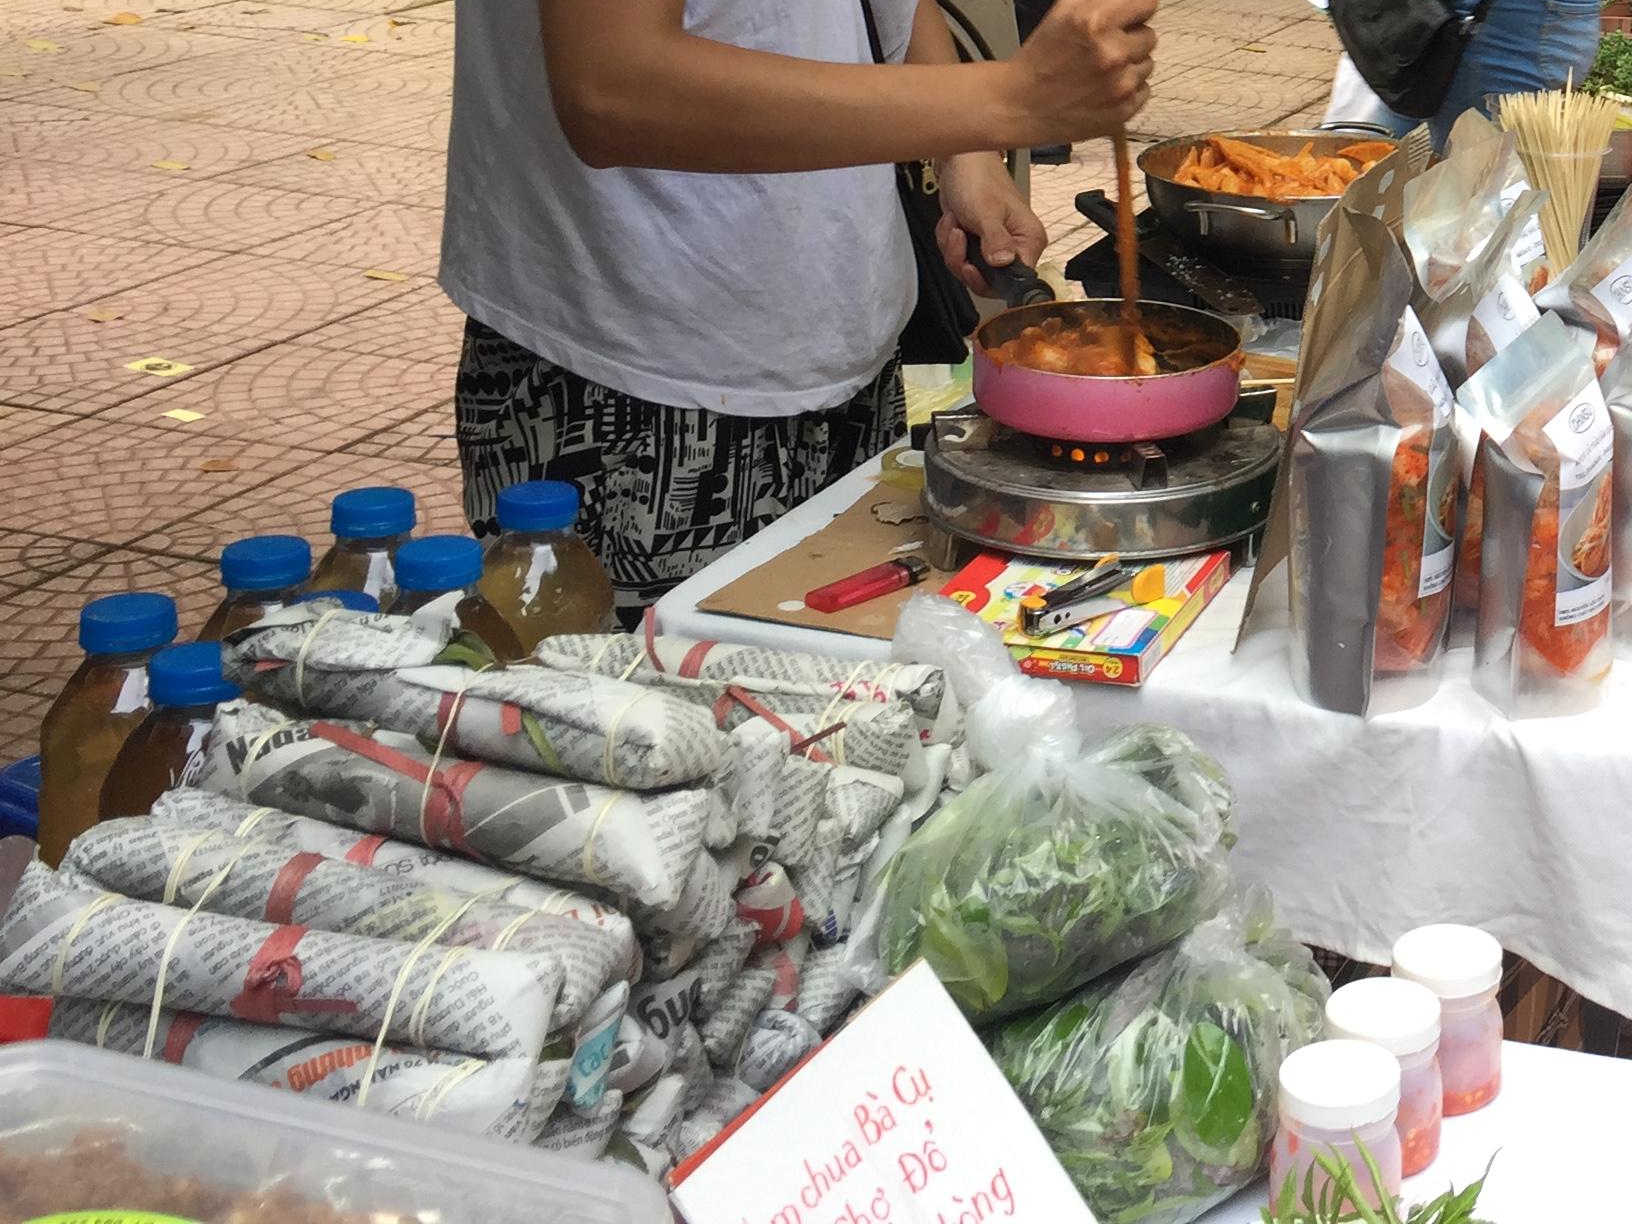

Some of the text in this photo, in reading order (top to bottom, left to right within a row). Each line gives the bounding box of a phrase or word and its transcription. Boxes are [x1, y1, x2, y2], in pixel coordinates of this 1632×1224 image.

[801, 1065, 934, 1209] chua Bà Cụ
